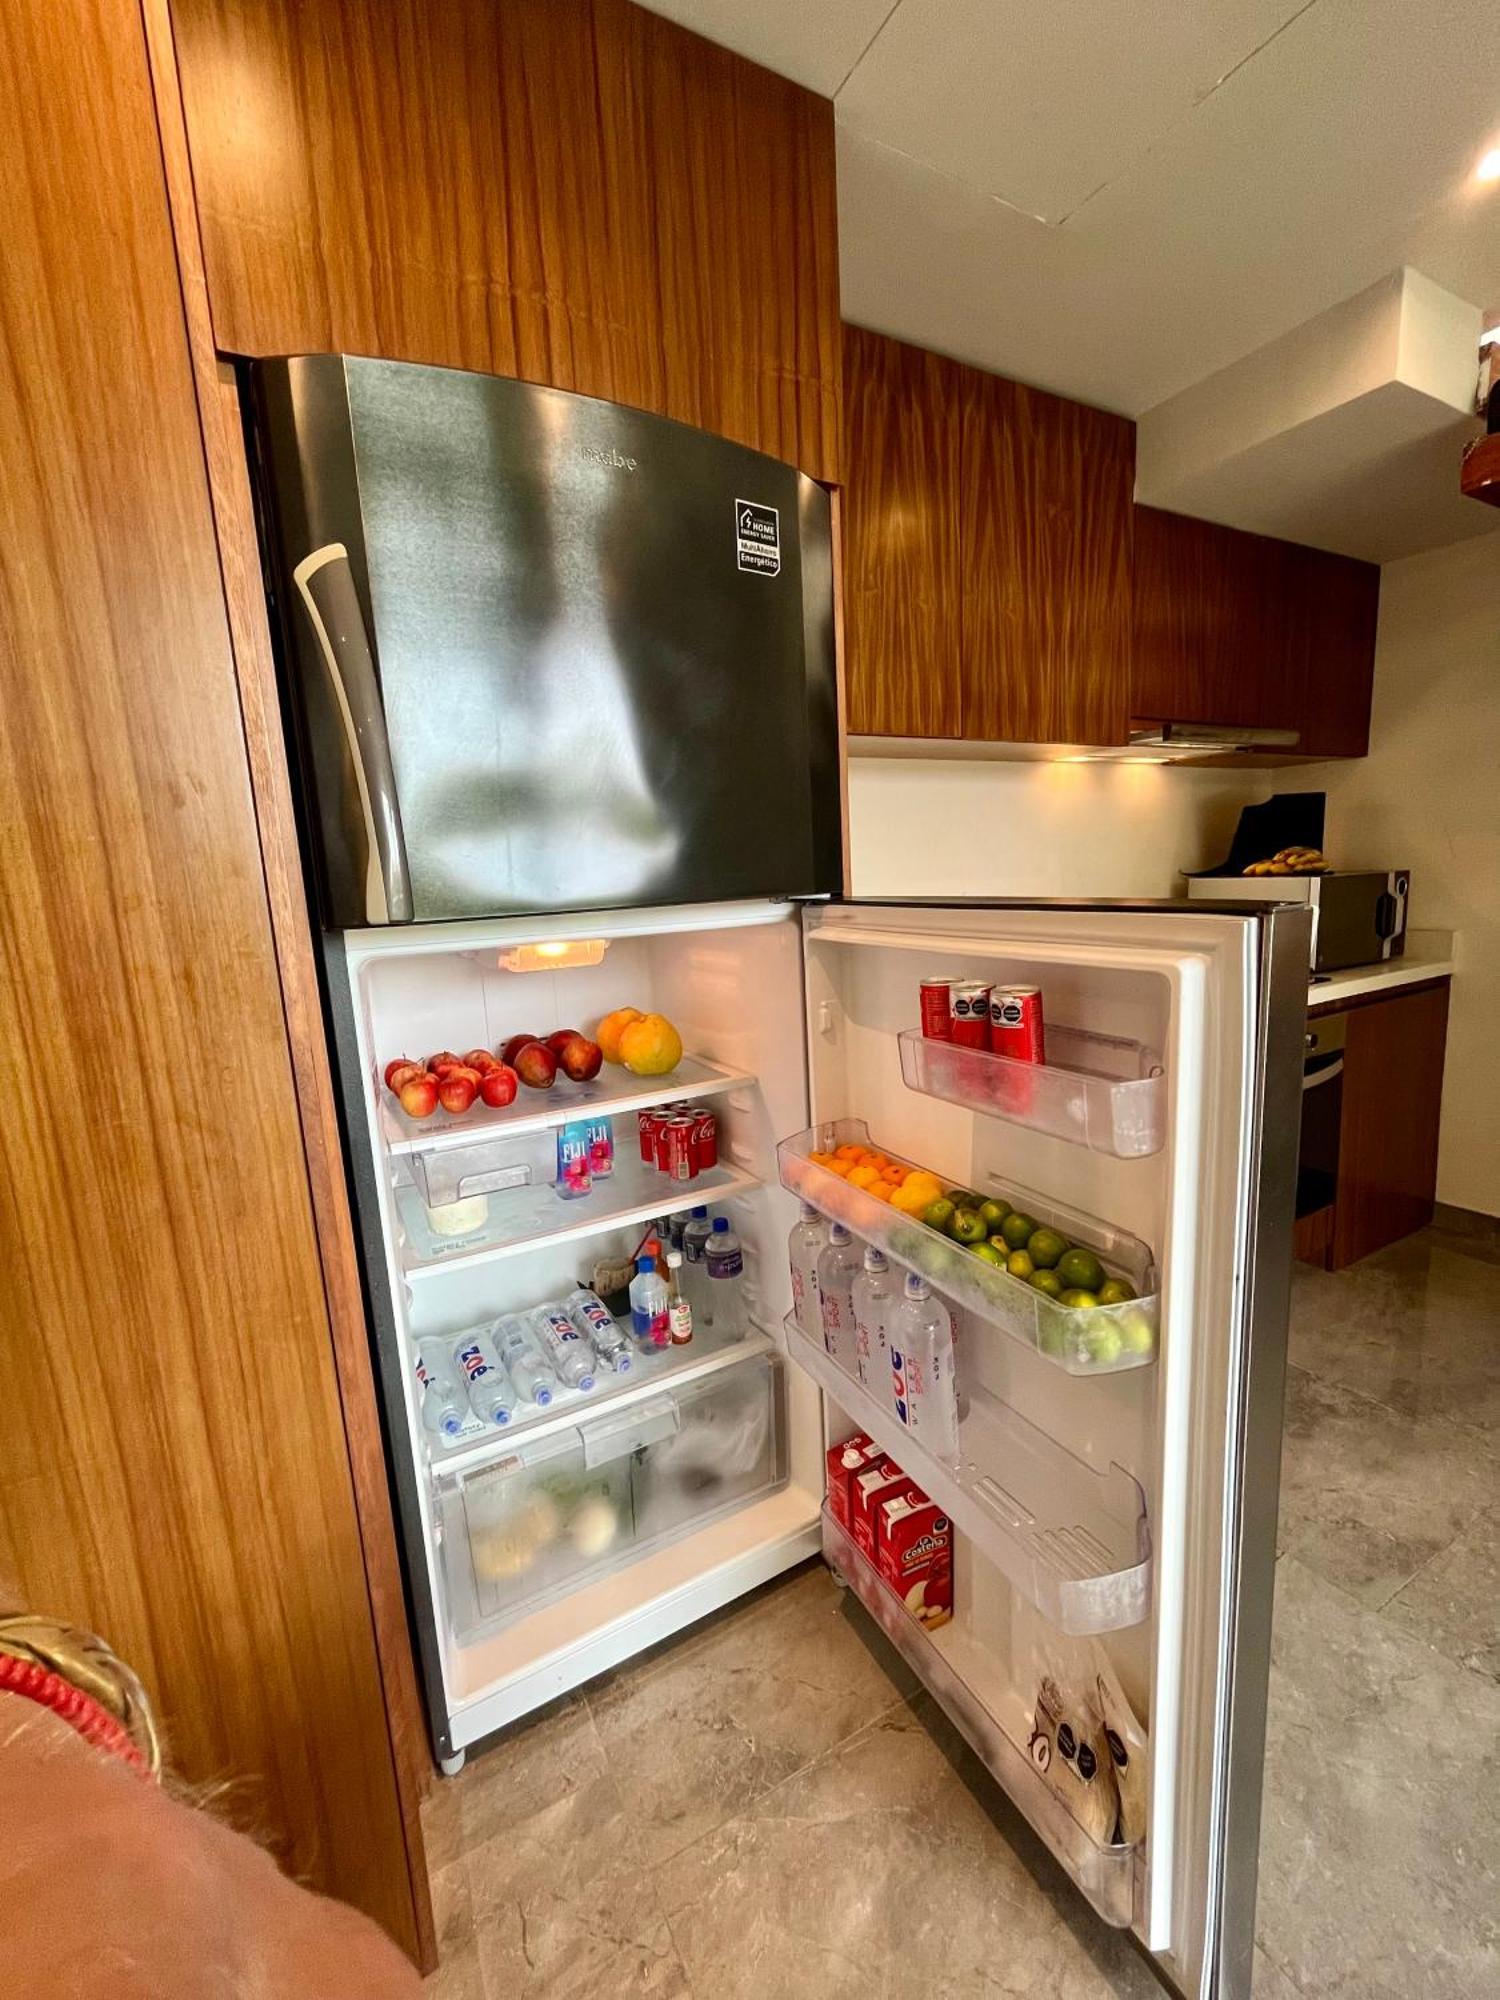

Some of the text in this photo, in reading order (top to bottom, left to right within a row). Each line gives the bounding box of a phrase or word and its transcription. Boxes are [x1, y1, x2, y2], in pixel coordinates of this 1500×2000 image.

[580, 447, 637, 471] mabe
[752, 522, 775, 536] HOME
[563, 1140, 586, 1163] FIJI
